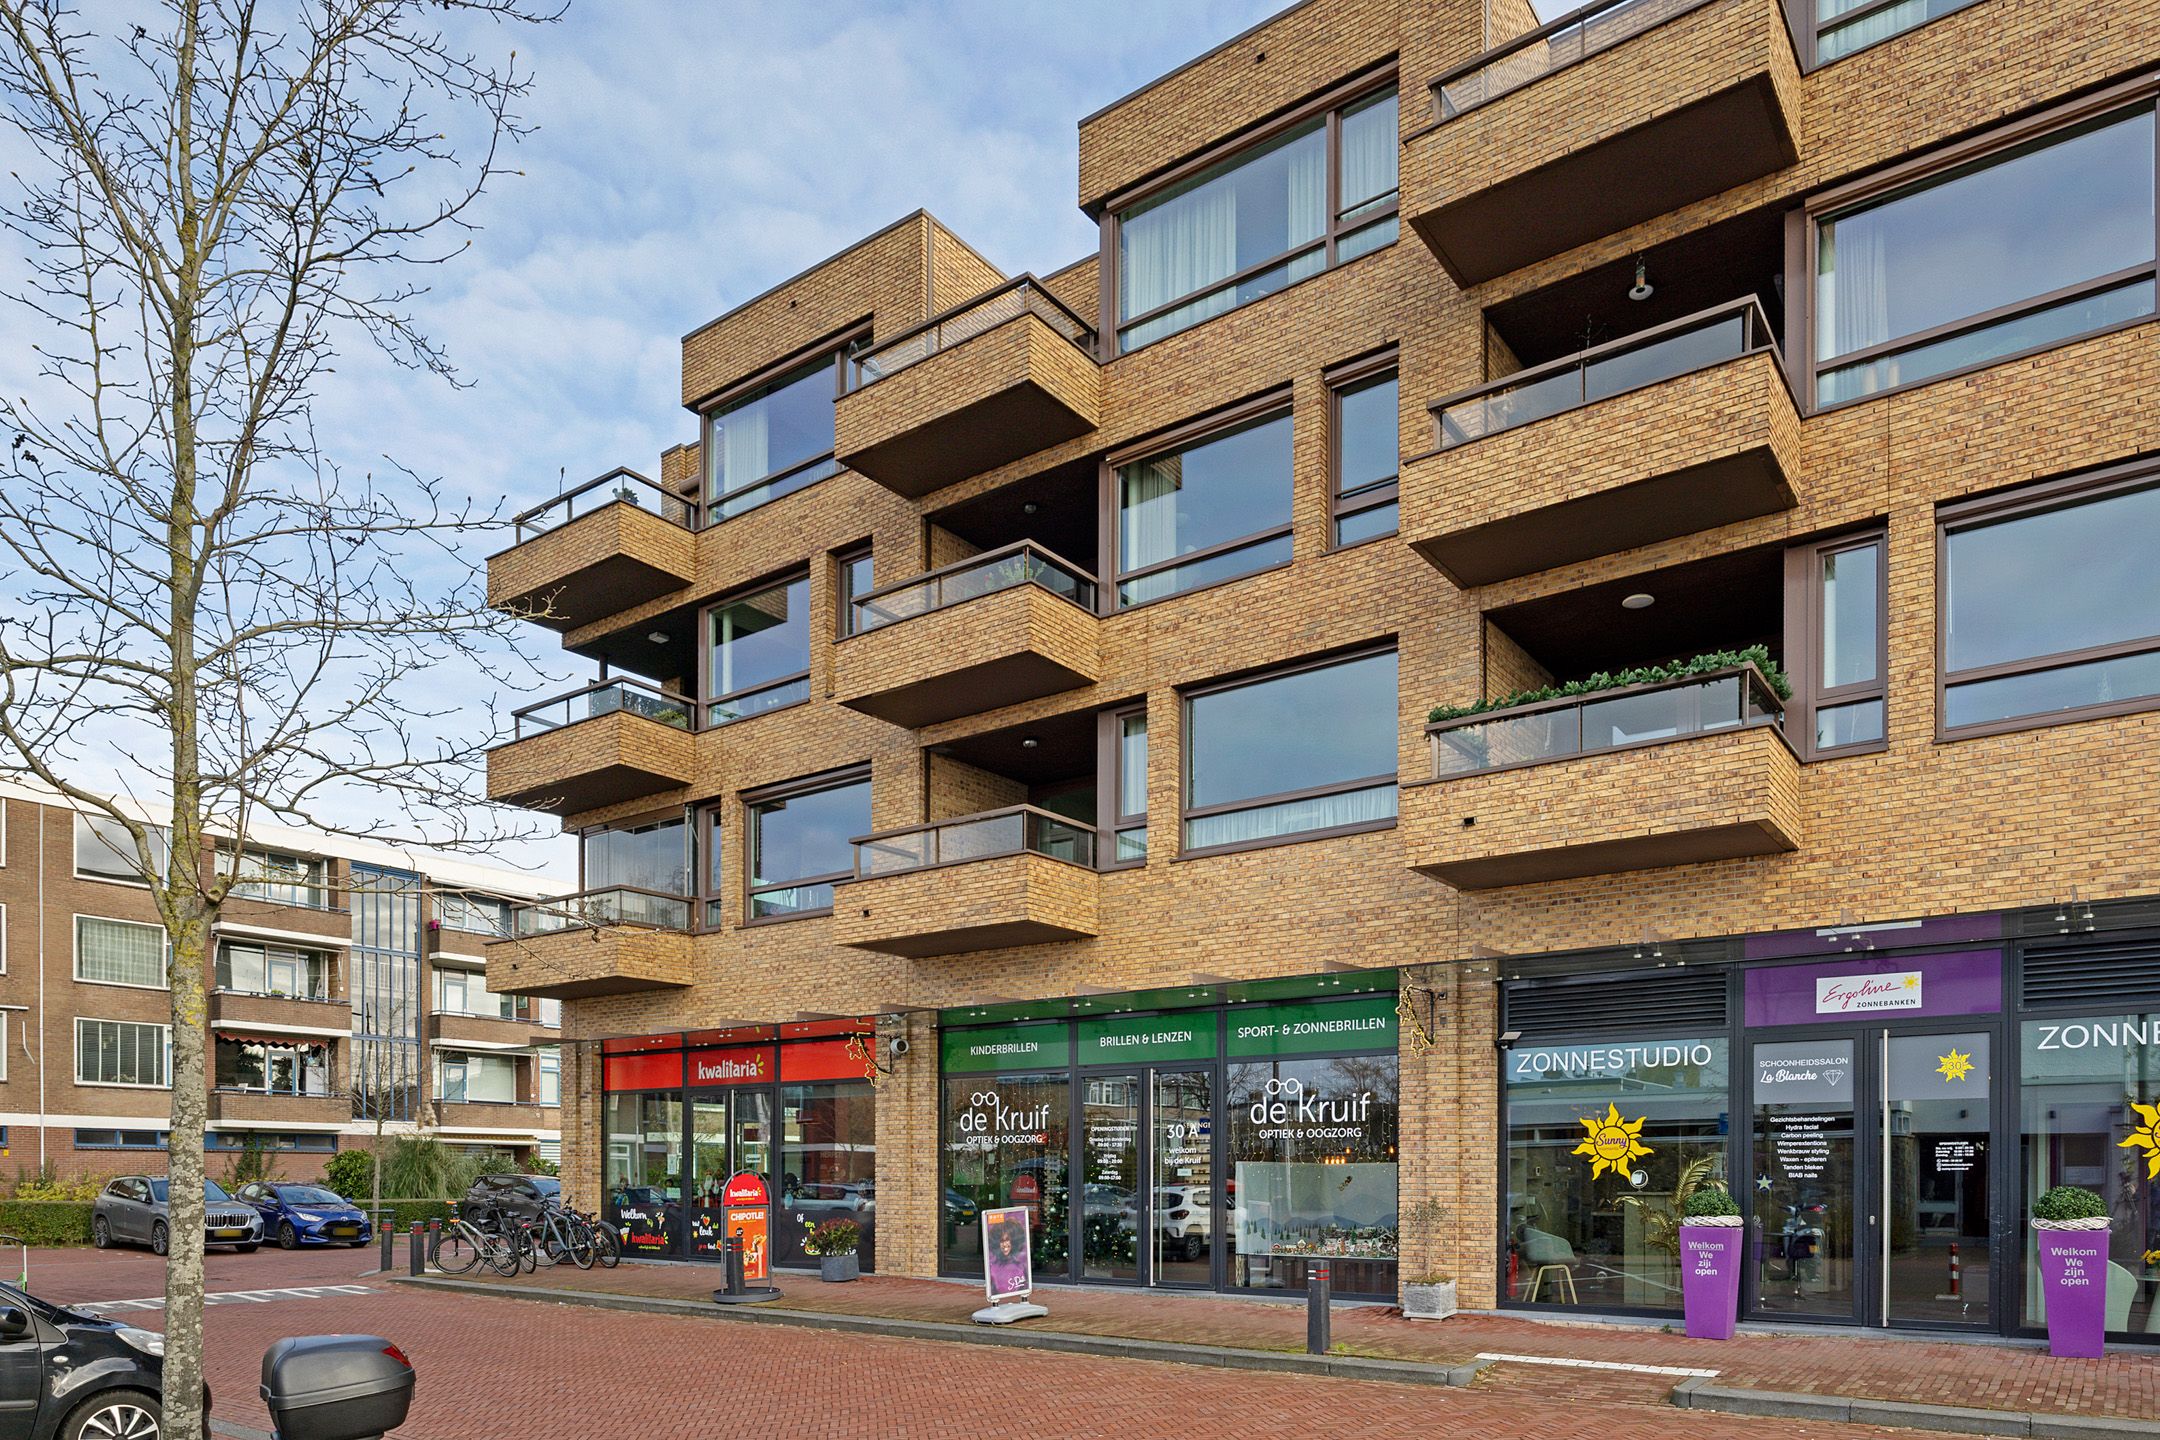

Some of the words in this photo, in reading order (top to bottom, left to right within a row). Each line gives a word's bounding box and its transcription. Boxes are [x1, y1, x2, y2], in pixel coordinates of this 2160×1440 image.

[1822, 980, 1901, 1010] Ergoline
[1856, 999, 1916, 1009] ZONNEBANKEN
[1237, 1025, 1279, 1038] SPORT-
[1282, 1024, 1291, 1035] &
[1293, 1017, 1386, 1035] ZONNEBRILLEN
[1100, 1035, 1140, 1047] BRILLEN
[1142, 1033, 1150, 1044] &
[1152, 1031, 1192, 1044] LENZEN
[970, 1042, 1038, 1056] KINDERBRILLEN
[1516, 1044, 1712, 1073] ZONNESTUDIO
[1759, 1057, 1849, 1068] SCHOONHEIDSSALON
[698, 1059, 757, 1080] kwalitaria
[1760, 1070, 1775, 1084] La
[1775, 1068, 1818, 1083] Blanche
[1250, 1096, 1287, 1125] de
[1298, 1083, 1371, 1123] Kruif
[960, 1107, 987, 1132] de
[996, 1096, 1050, 1131] Kruif
[1167, 1124, 1185, 1139] 30
[1188, 1124, 1199, 1138] A
[1259, 1128, 1295, 1139] OPTIEK
[1296, 1128, 1304, 1138] &
[1306, 1127, 1362, 1139] OOGZORG
[966, 1135, 993, 1145] OPTIEK
[994, 1134, 1000, 1144] &
[1001, 1134, 1043, 1144] OOGZORG
[1595, 1133, 1627, 1149] Sunny
[1169, 1146, 1197, 1154] welkom
[1174, 1156, 1184, 1165] de
[1184, 1155, 1202, 1164] Kruif
[620, 1208, 648, 1220] Welkom
[730, 1211, 765, 1221] CHIPOTLE!
[631, 1231, 665, 1246] kwalitaria
[1688, 1241, 1724, 1250] Welkom
[2050, 1247, 2097, 1256] Welkom
[1699, 1251, 1714, 1259] We
[2065, 1258, 2084, 1267] We
[1695, 1268, 1718, 1277] open
[2064, 1267, 2085, 1278] zijn
[2060, 1278, 2089, 1287] open
